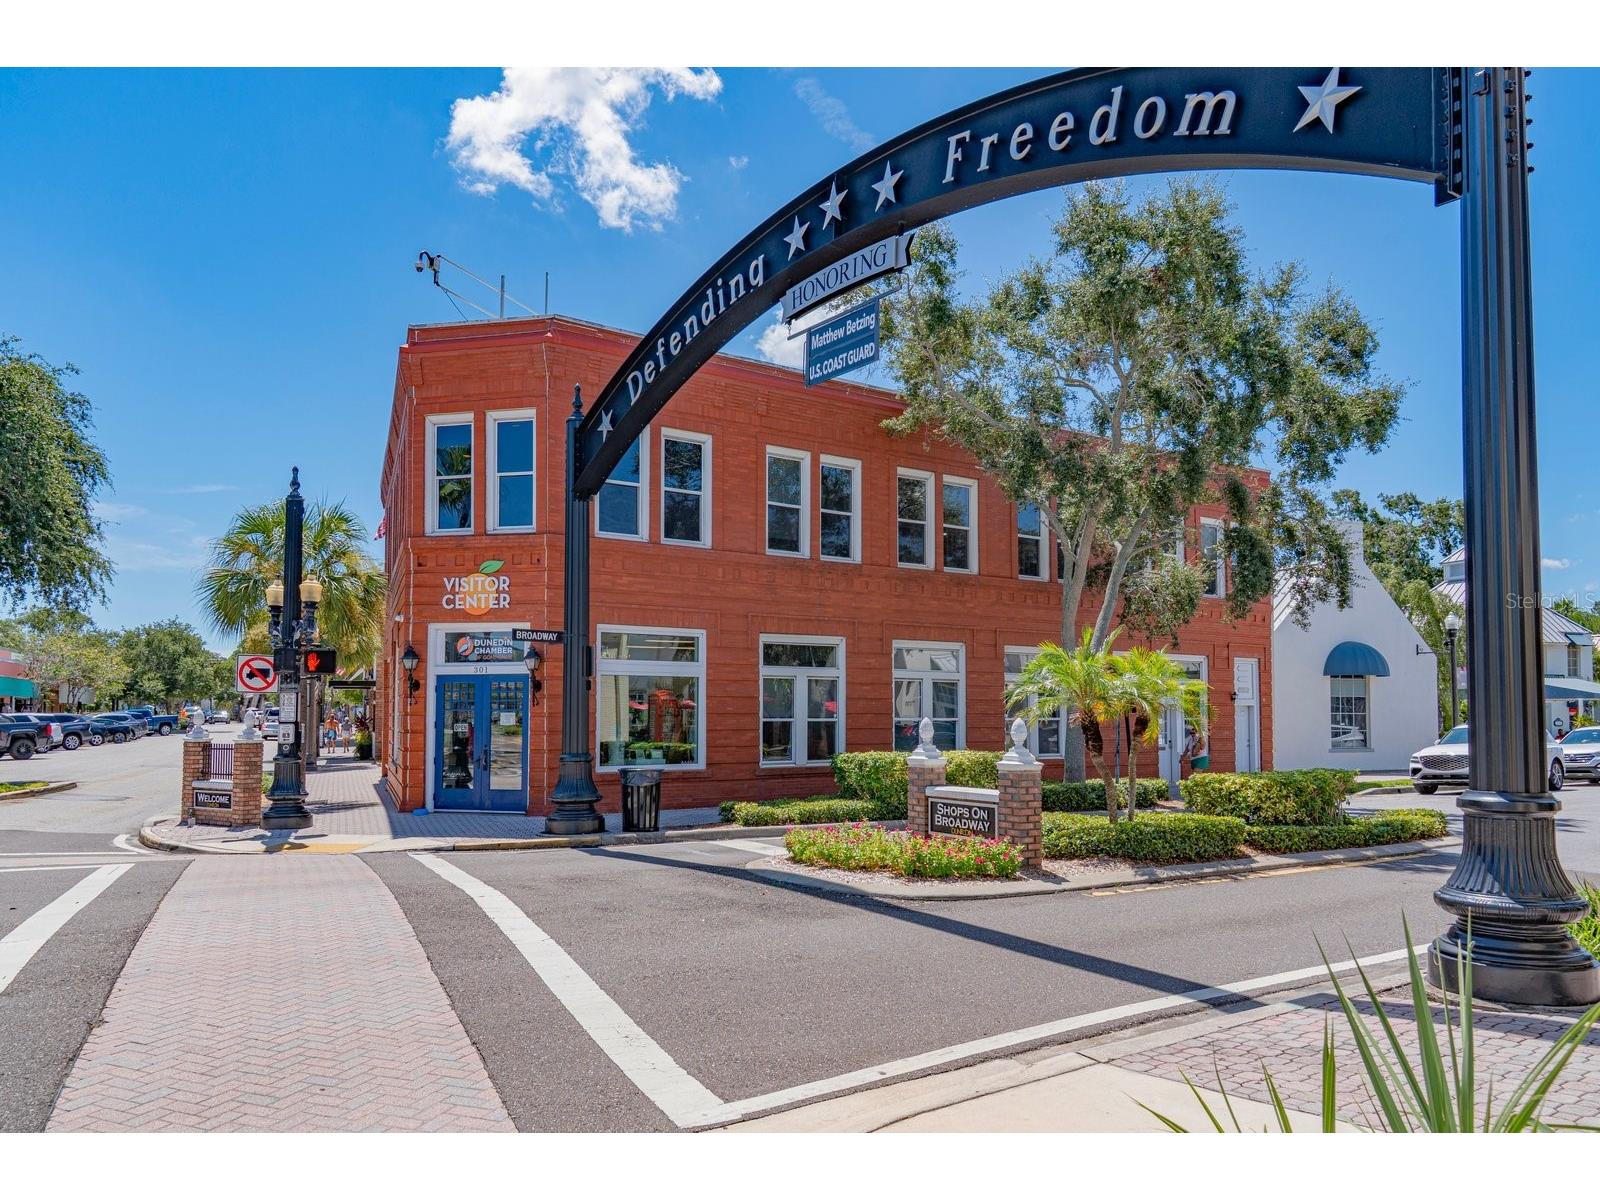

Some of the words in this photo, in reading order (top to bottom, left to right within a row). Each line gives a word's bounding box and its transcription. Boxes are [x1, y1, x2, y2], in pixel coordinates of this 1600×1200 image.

[626, 254, 765, 406] Defending
[942, 85, 1237, 184] Freedom
[792, 244, 887, 310] HONORING
[811, 326, 845, 350] Matthew
[846, 313, 876, 335] Betzing
[809, 363, 823, 380] U.S.
[822, 352, 848, 375] COAST
[847, 342, 875, 362] GUARD
[443, 576, 511, 593] VISITOR
[441, 593, 511, 609] CENTER
[474, 638, 513, 647] DUNEDIN
[516, 630, 559, 641] BROADWAY
[474, 646, 513, 655] CHAMBER
[473, 666, 489, 674] 301
[197, 793, 230, 804] WELCOME
[937, 803, 970, 818] SHOPS
[971, 807, 988, 820] ON
[935, 814, 990, 832] BROADWAY
